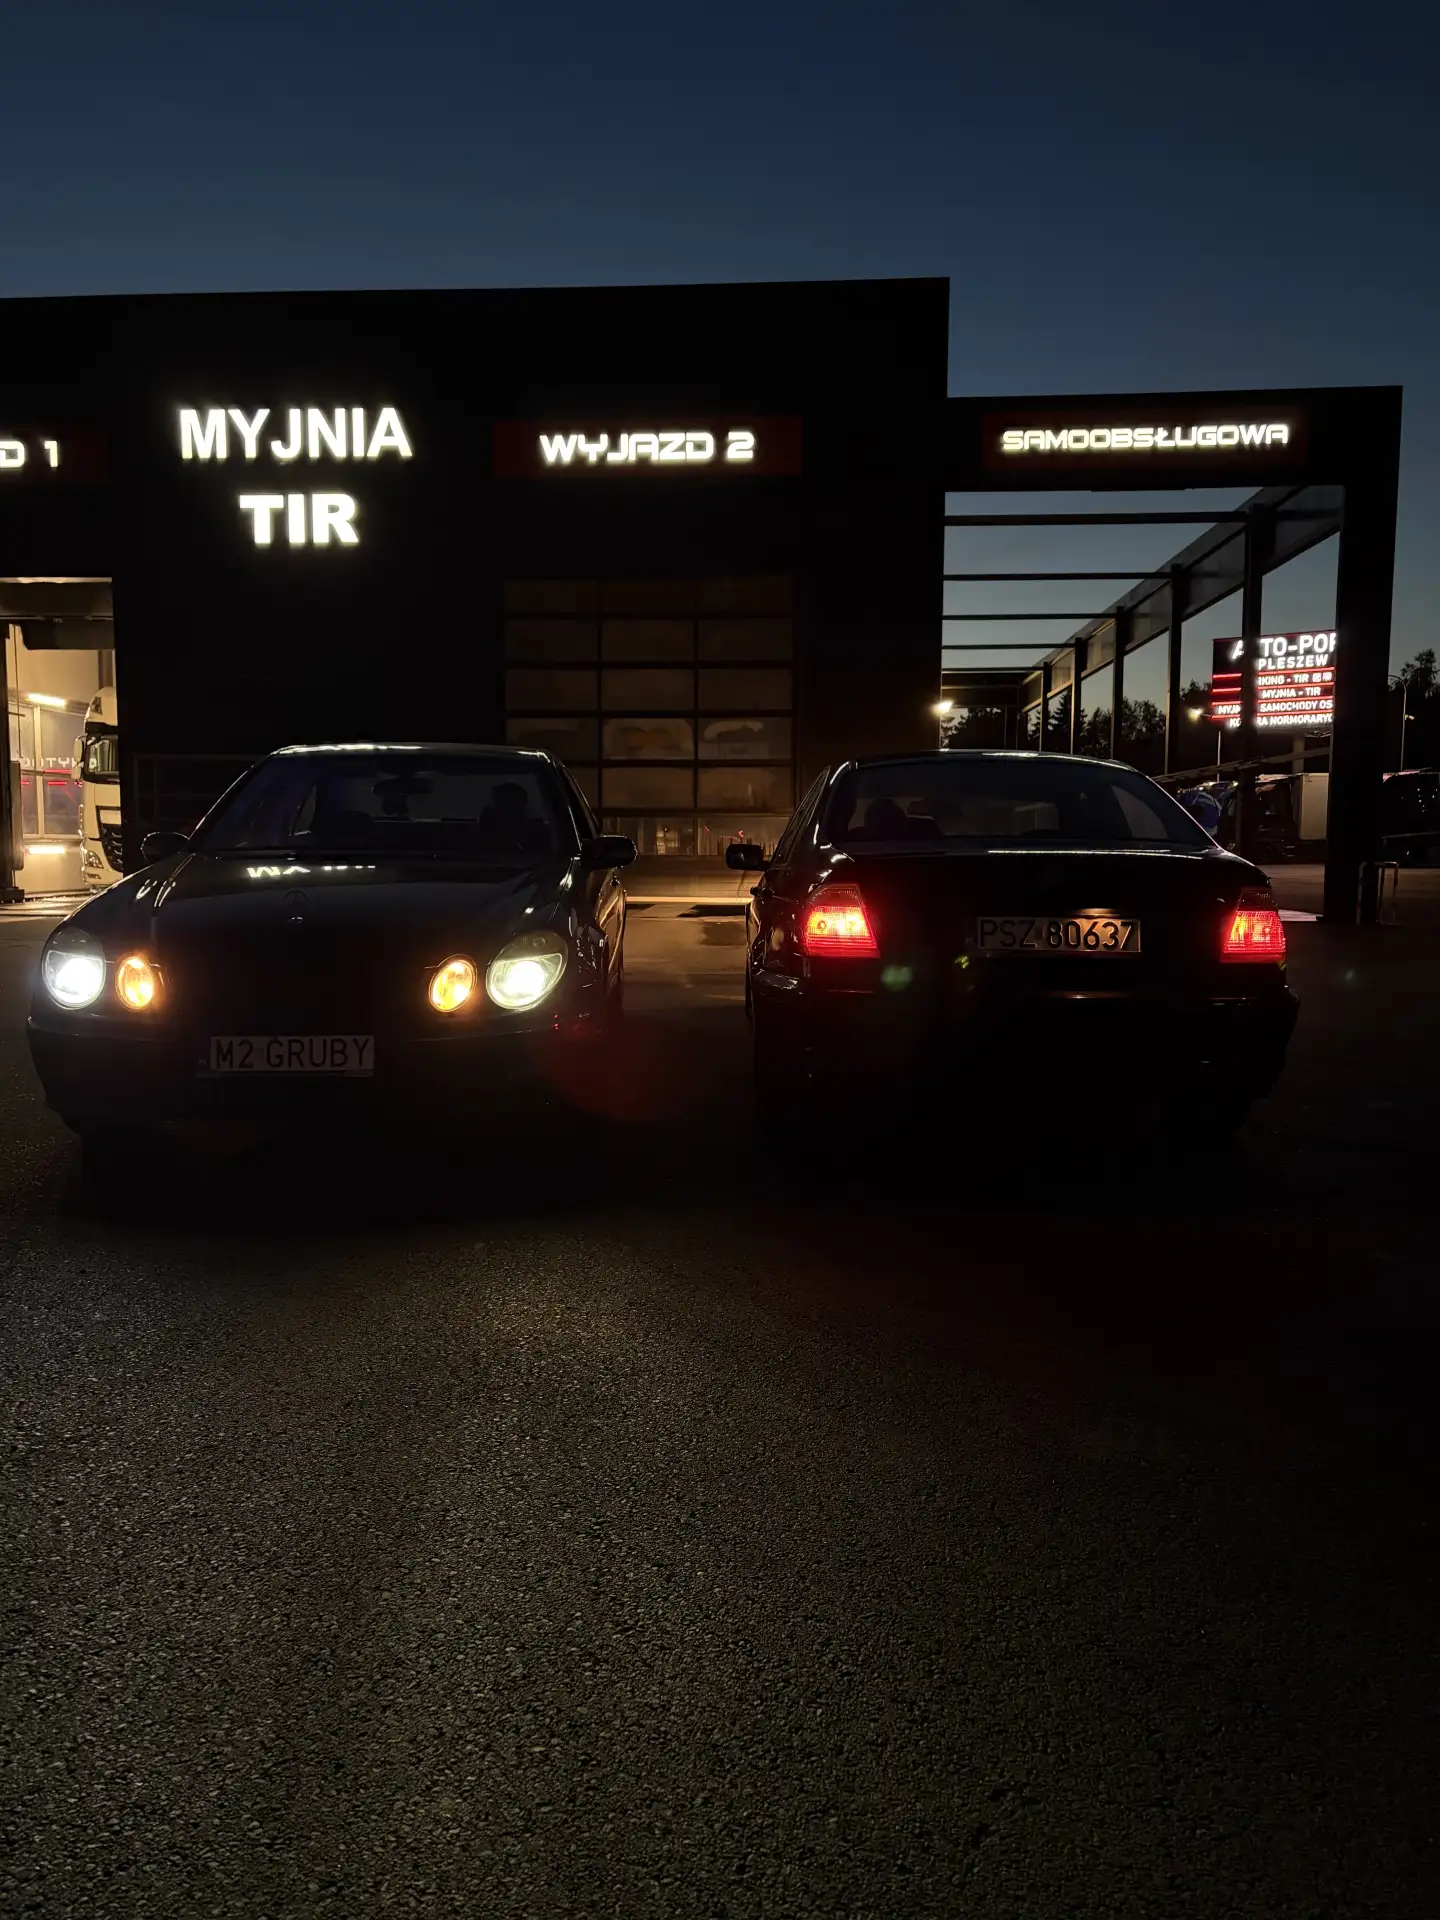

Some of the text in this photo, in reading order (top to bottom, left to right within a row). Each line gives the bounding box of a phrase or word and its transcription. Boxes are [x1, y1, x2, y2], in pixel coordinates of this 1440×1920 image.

[180, 408, 412, 460] MYJNIA
[539, 432, 756, 463] WYJAZD 2
[1003, 424, 1289, 450] SAMOOBSŁUGOWA
[44, 441, 58, 467] 1
[240, 493, 358, 544] TIR
[1232, 632, 1337, 660] ATO-PO
[1258, 654, 1328, 671] PLESZEW
[1294, 673, 1309, 683] TIR
[1262, 688, 1297, 699] MYJNIA
[1305, 687, 1321, 696] TIR
[1260, 701, 1317, 713] SAMOCHODY
[980, 919, 1134, 951] PSZ 80637
[216, 1037, 370, 1069] M2 GRUBY
